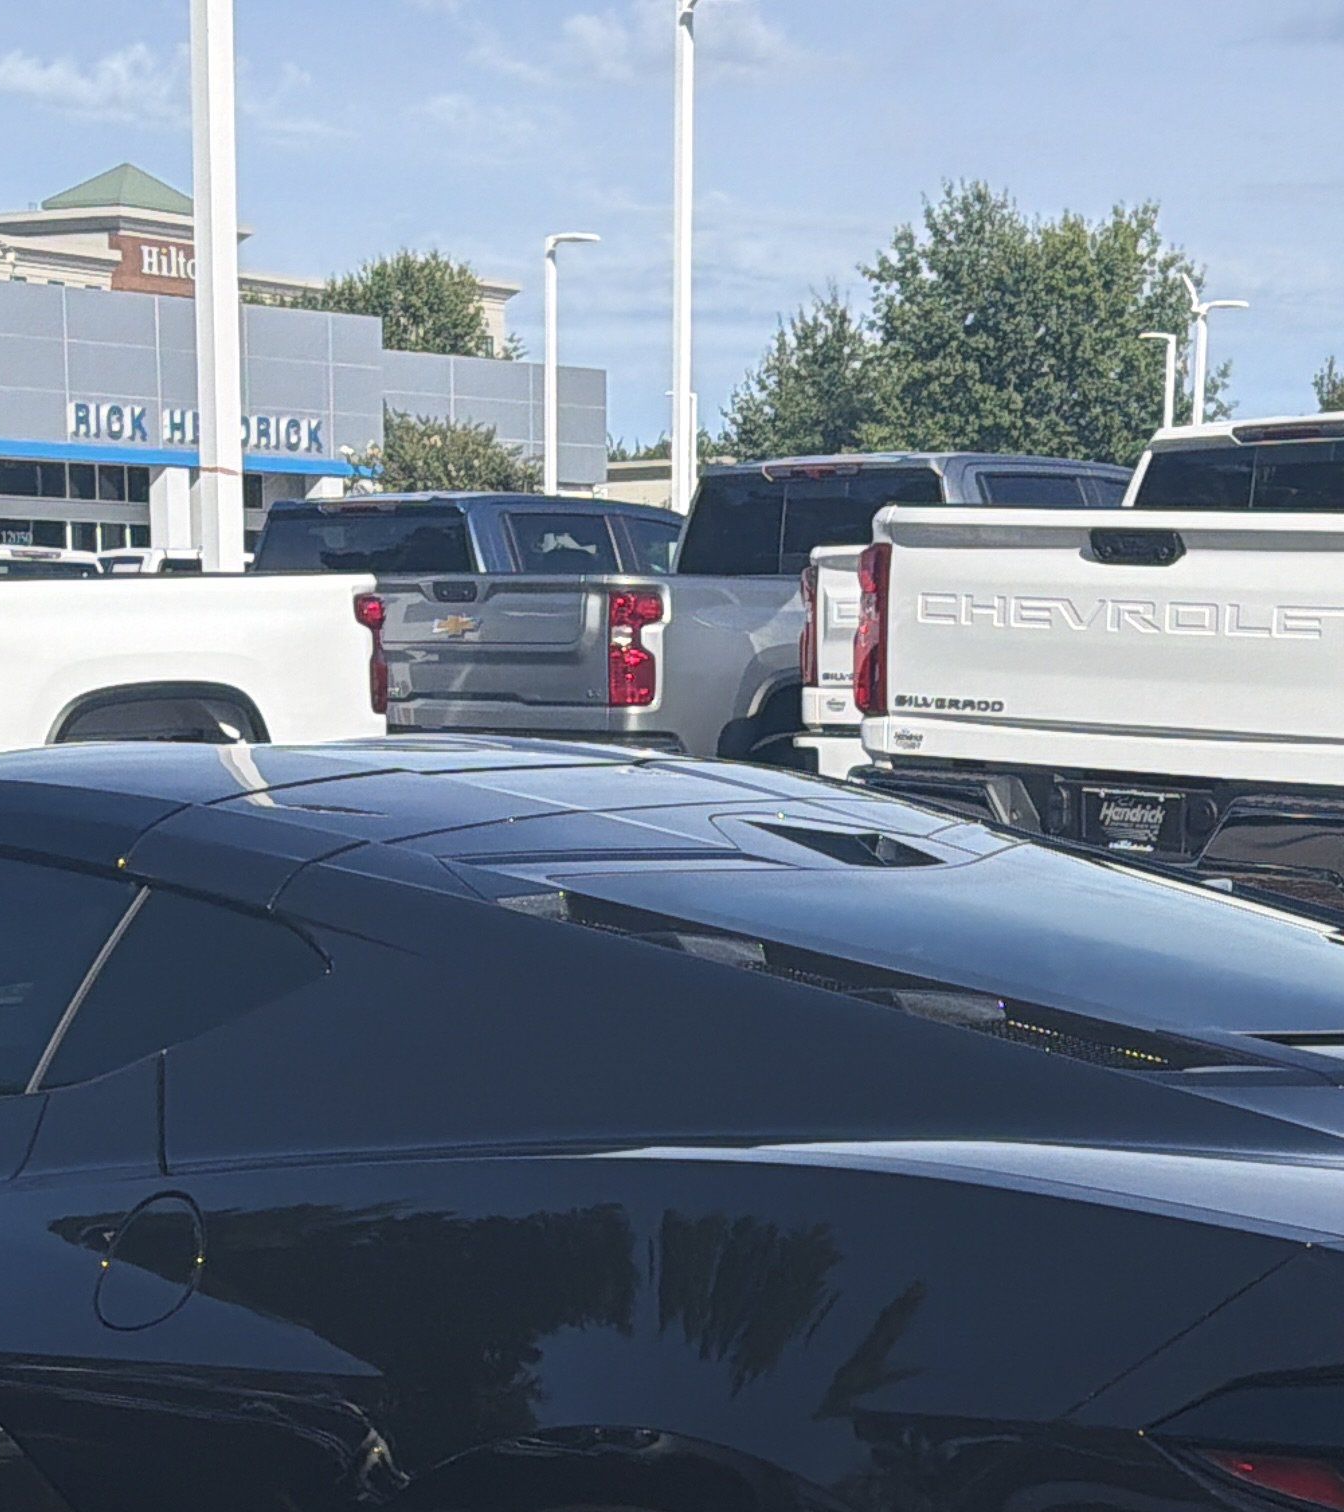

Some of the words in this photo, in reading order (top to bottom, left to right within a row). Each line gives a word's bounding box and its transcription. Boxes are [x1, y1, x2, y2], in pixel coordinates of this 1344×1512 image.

[140, 244, 196, 280] Hilto
[68, 401, 148, 442] RICK
[895, 694, 1005, 713] SILVERADO
[1099, 801, 1166, 826] Hendrick
